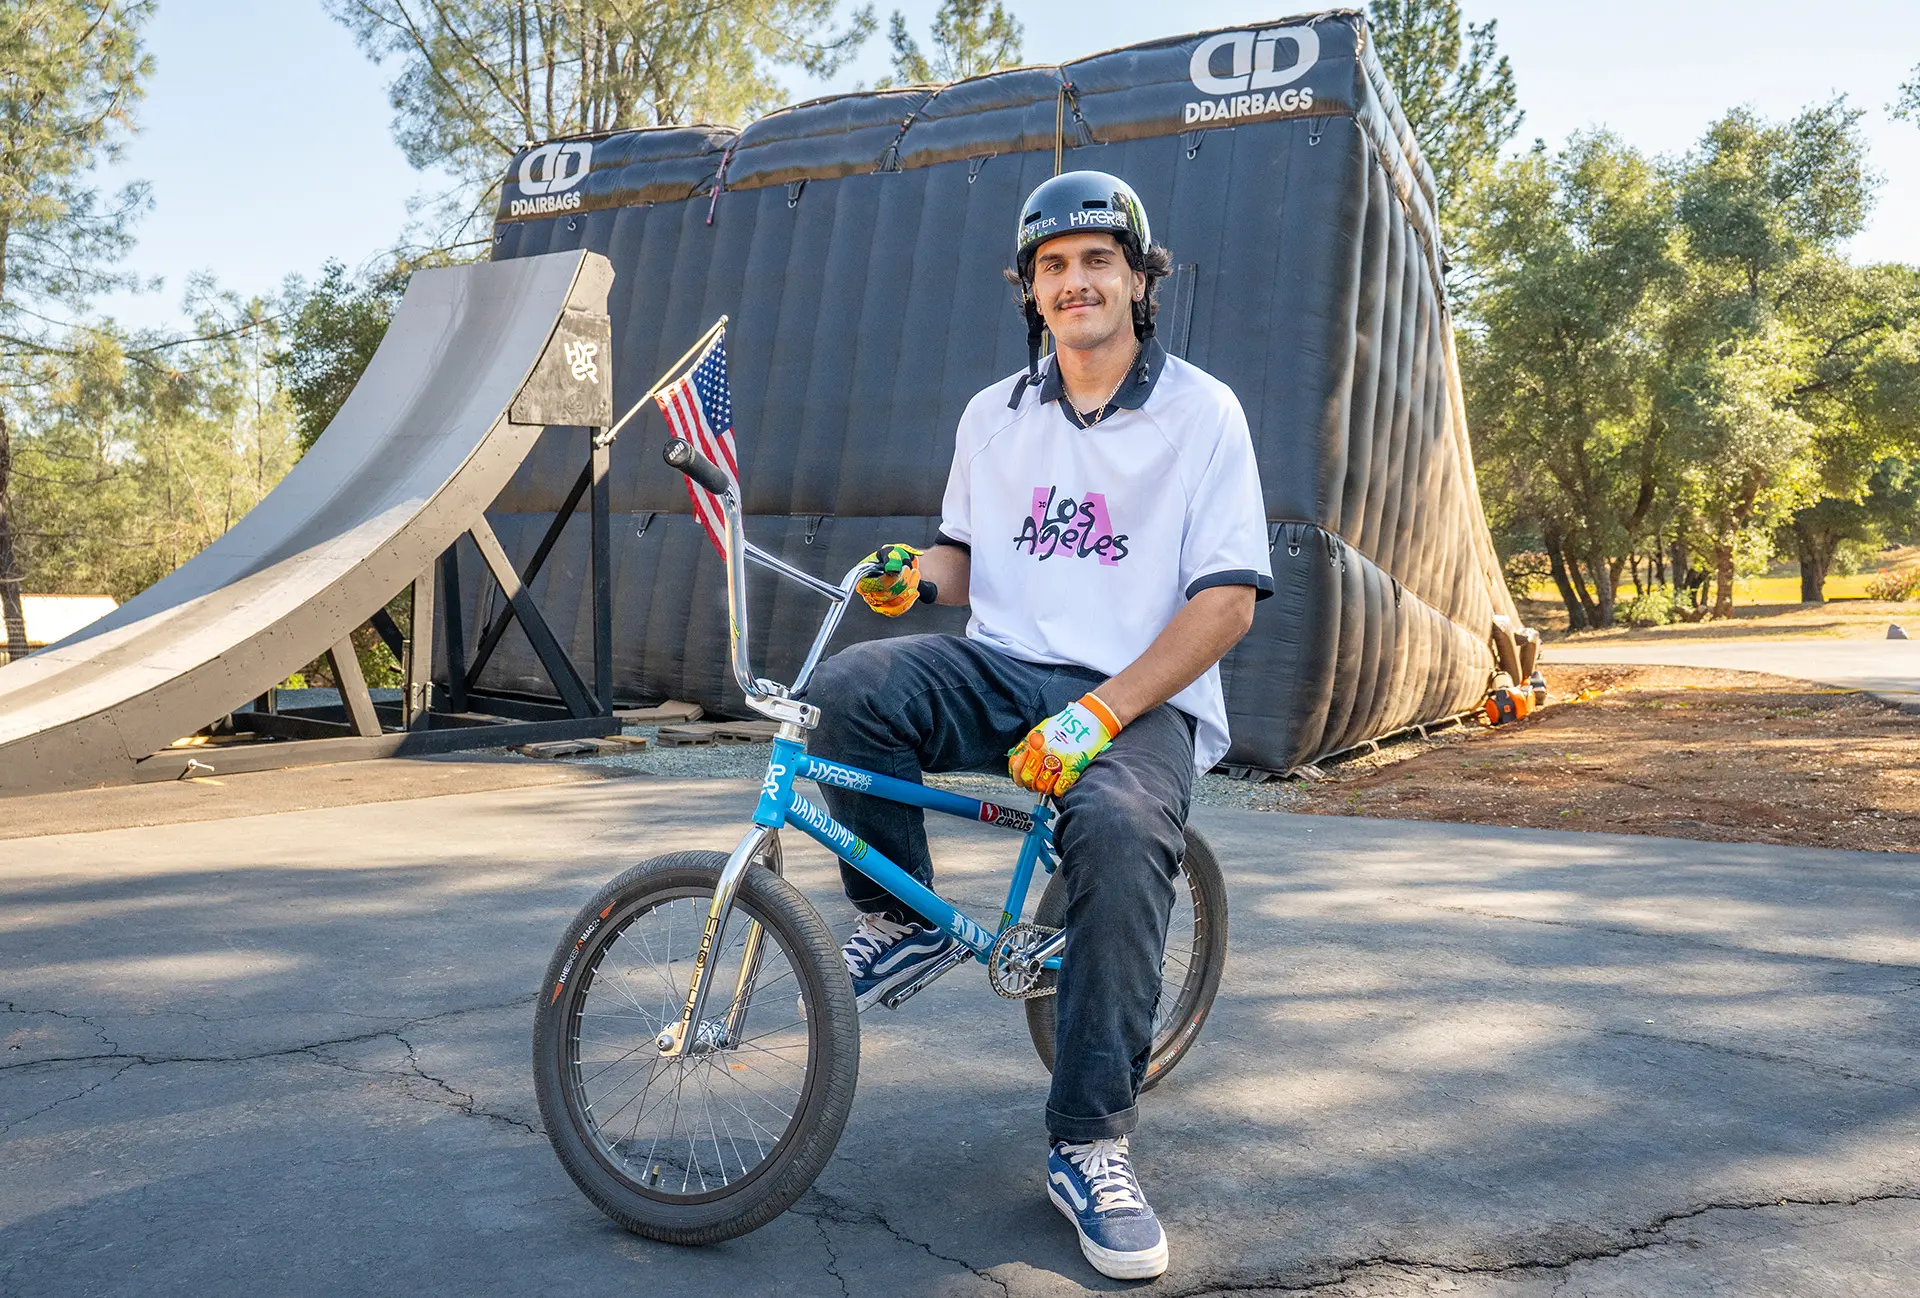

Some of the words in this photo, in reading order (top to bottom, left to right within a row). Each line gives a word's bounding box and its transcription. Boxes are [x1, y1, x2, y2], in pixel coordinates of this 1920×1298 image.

[1185, 87, 1314, 124] DDAIRBAGS
[510, 190, 581, 216] DDAIRBAGS
[1041, 485, 1096, 530] Los
[1056, 708, 1091, 744] fist
[995, 816, 1034, 832] CIRCUS
[998, 806, 1030, 822] NITRO
